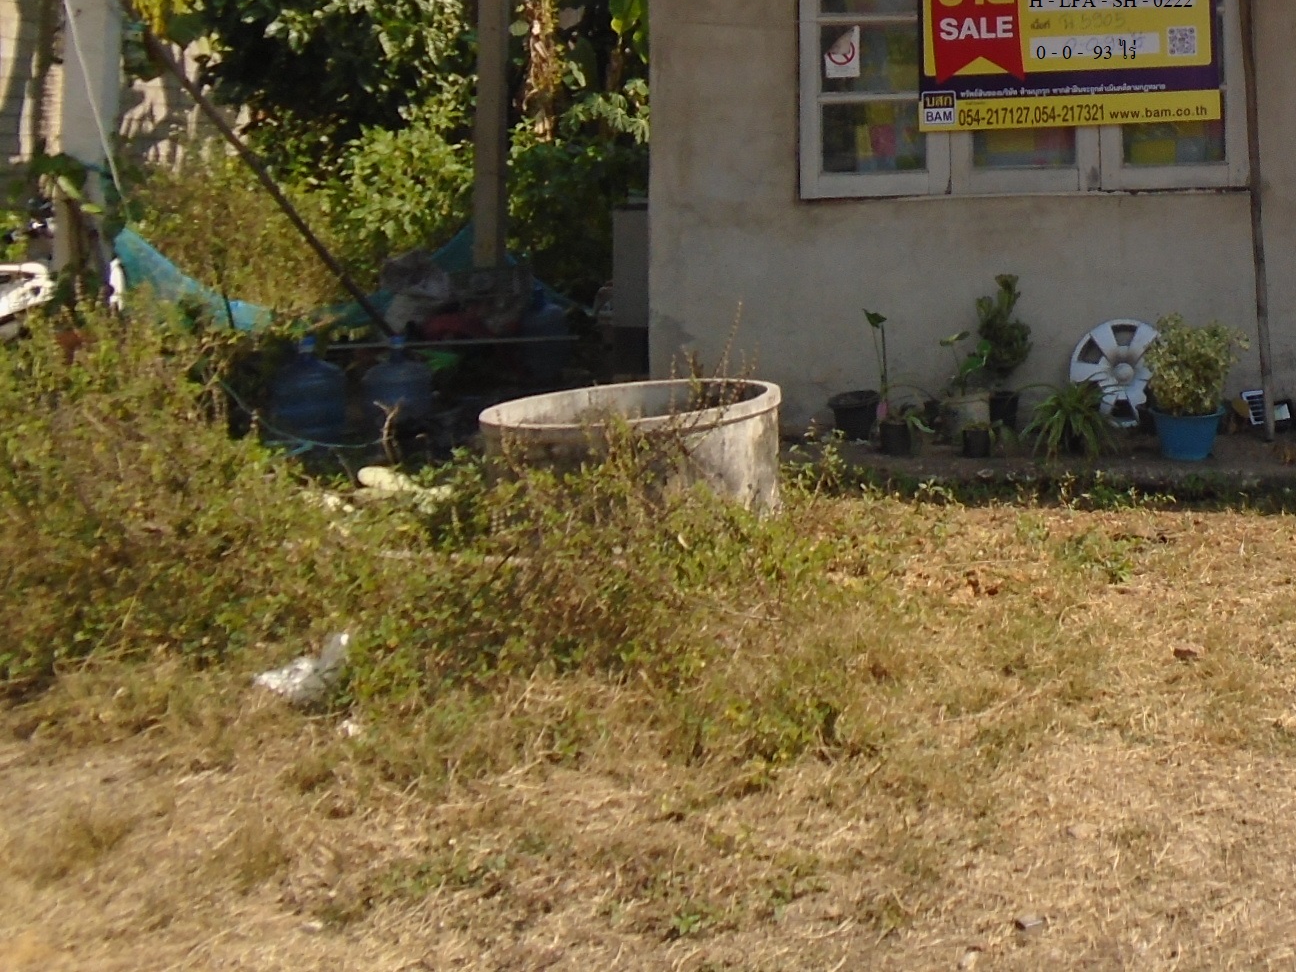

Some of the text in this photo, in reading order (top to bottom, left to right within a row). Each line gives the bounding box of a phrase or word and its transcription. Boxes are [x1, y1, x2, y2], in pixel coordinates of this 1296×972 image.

[939, 15, 1014, 41] SALE
[926, 110, 953, 123] BAM
[958, 103, 1207, 127] 054-217127,054-217321 www.bam.co.th
